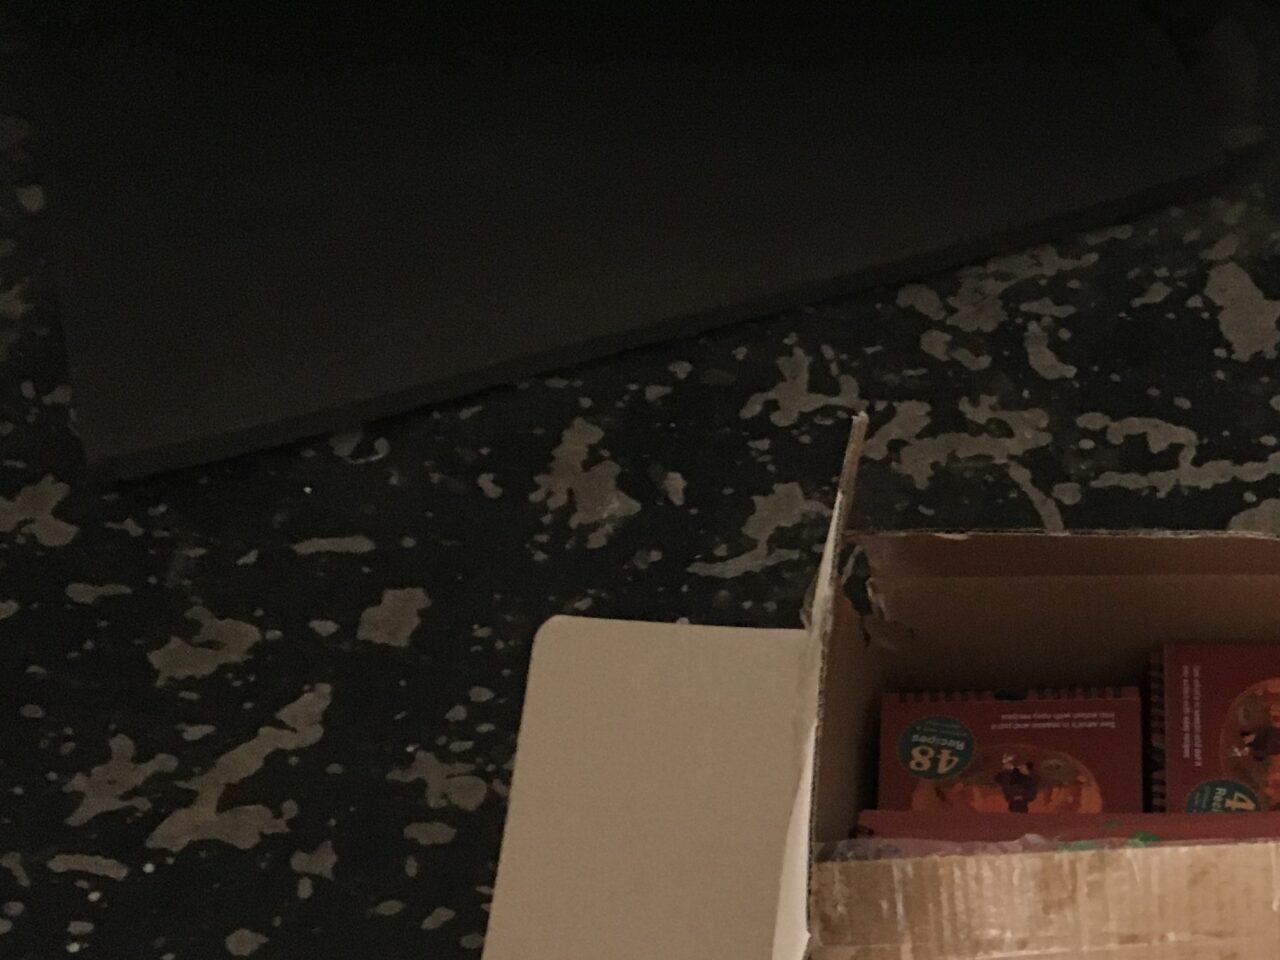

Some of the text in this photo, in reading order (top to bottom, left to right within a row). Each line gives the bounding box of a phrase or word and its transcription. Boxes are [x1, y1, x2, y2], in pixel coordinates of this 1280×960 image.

[911, 734, 965, 751] Recipes
[908, 744, 960, 775] 48
[1212, 787, 1227, 812] Reci
[1224, 791, 1257, 811] 4
